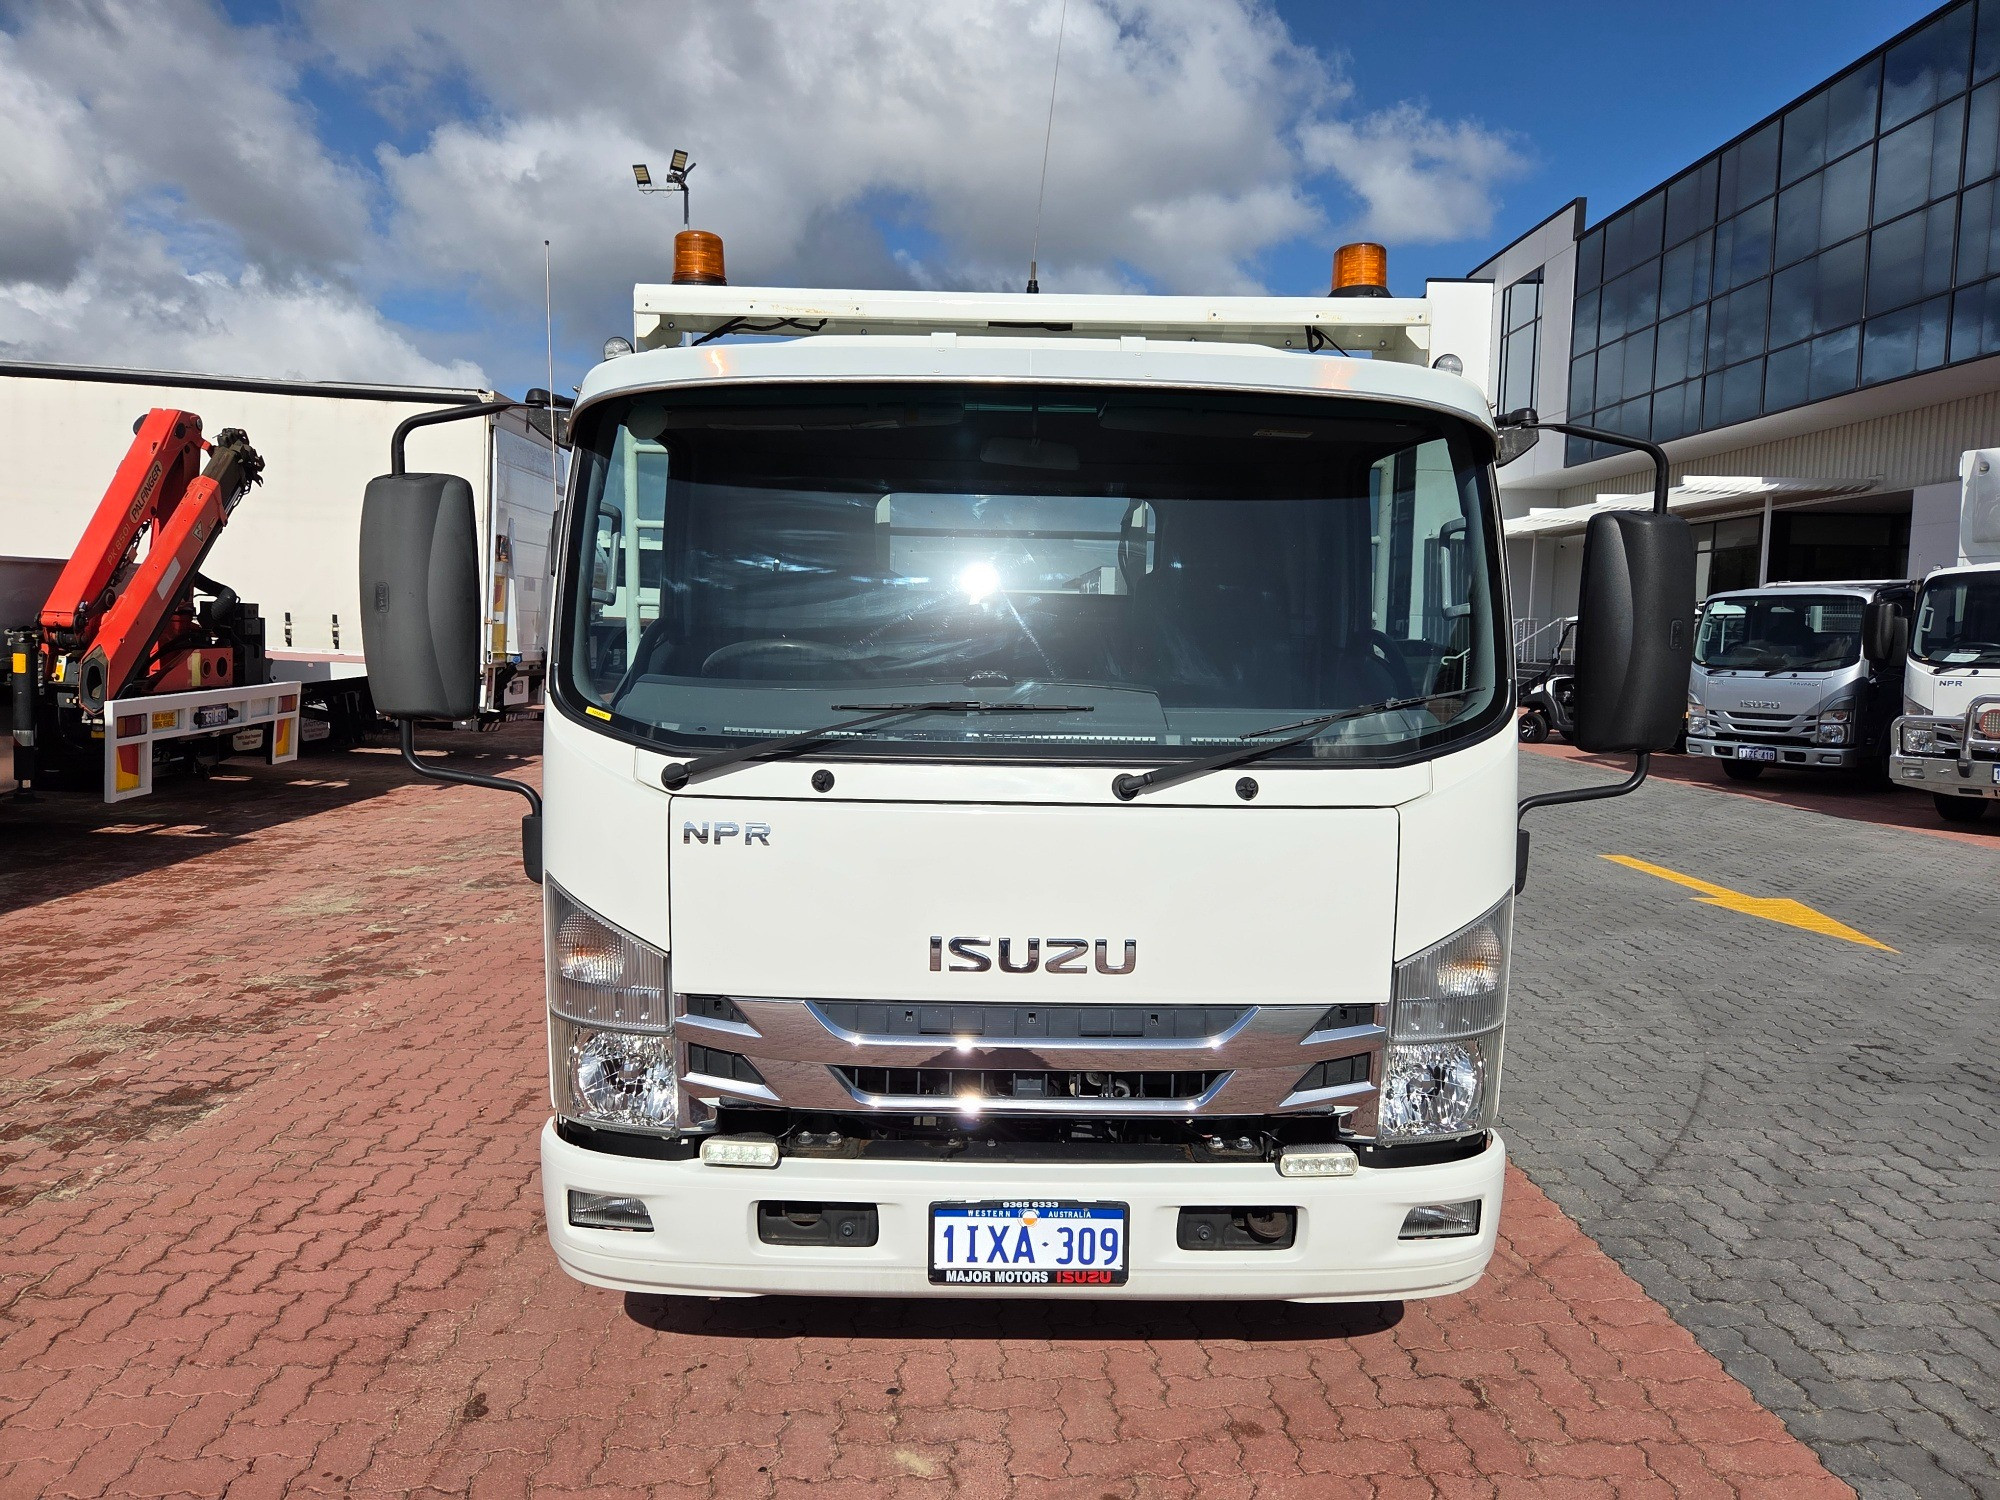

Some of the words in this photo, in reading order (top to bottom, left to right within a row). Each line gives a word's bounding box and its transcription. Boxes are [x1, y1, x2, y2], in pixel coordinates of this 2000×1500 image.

[131, 464, 162, 521] PALFINGER
[1740, 700, 1781, 710] ISUZU
[683, 820, 772, 846] NPR
[929, 936, 1137, 975] ISUZU
[967, 1209, 1011, 1218] WESTERN
[1048, 1210, 1092, 1219] AUSTRALIA
[945, 1270, 992, 1283] MAJOR
[994, 1270, 1049, 1284] MOTORS
[1056, 1271, 1112, 1284] ISUZU
